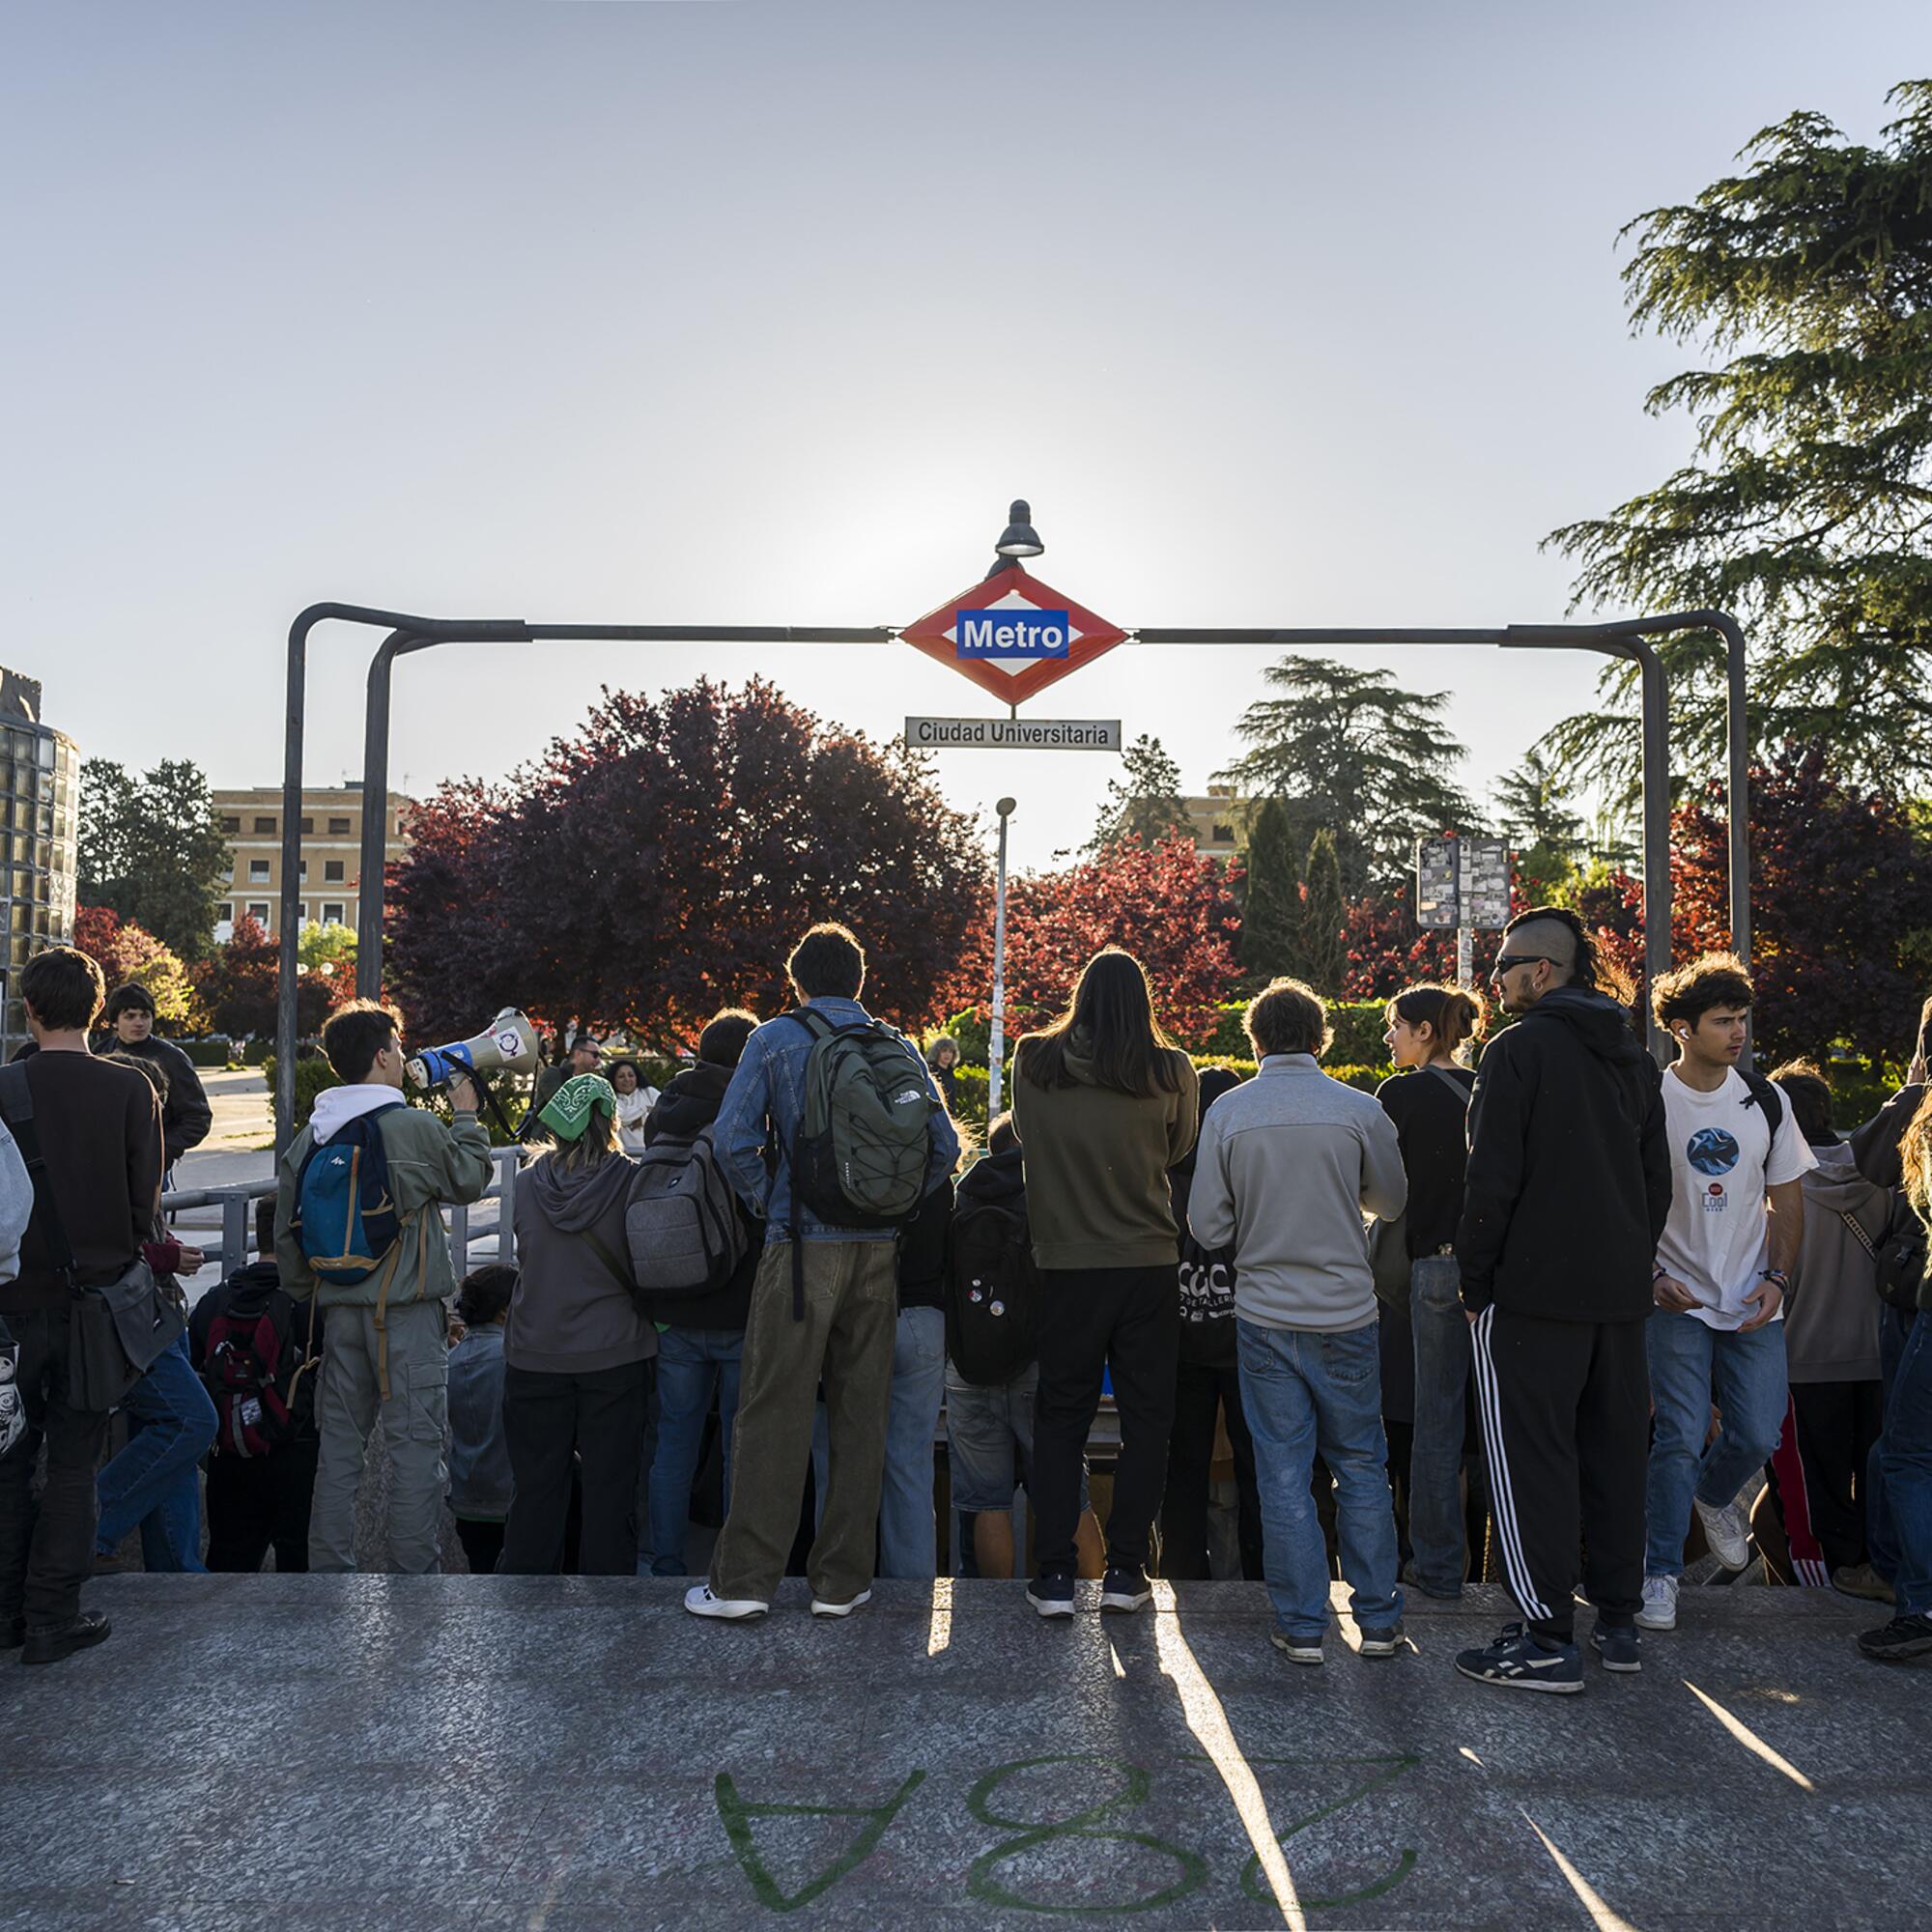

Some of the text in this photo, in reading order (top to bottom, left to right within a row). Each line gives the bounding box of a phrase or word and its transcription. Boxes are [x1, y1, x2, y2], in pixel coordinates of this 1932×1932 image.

[964, 620, 1063, 648] Metro
[918, 722, 1109, 744] Ciudad Universitaria
[1701, 1192, 1728, 1208] Cool
